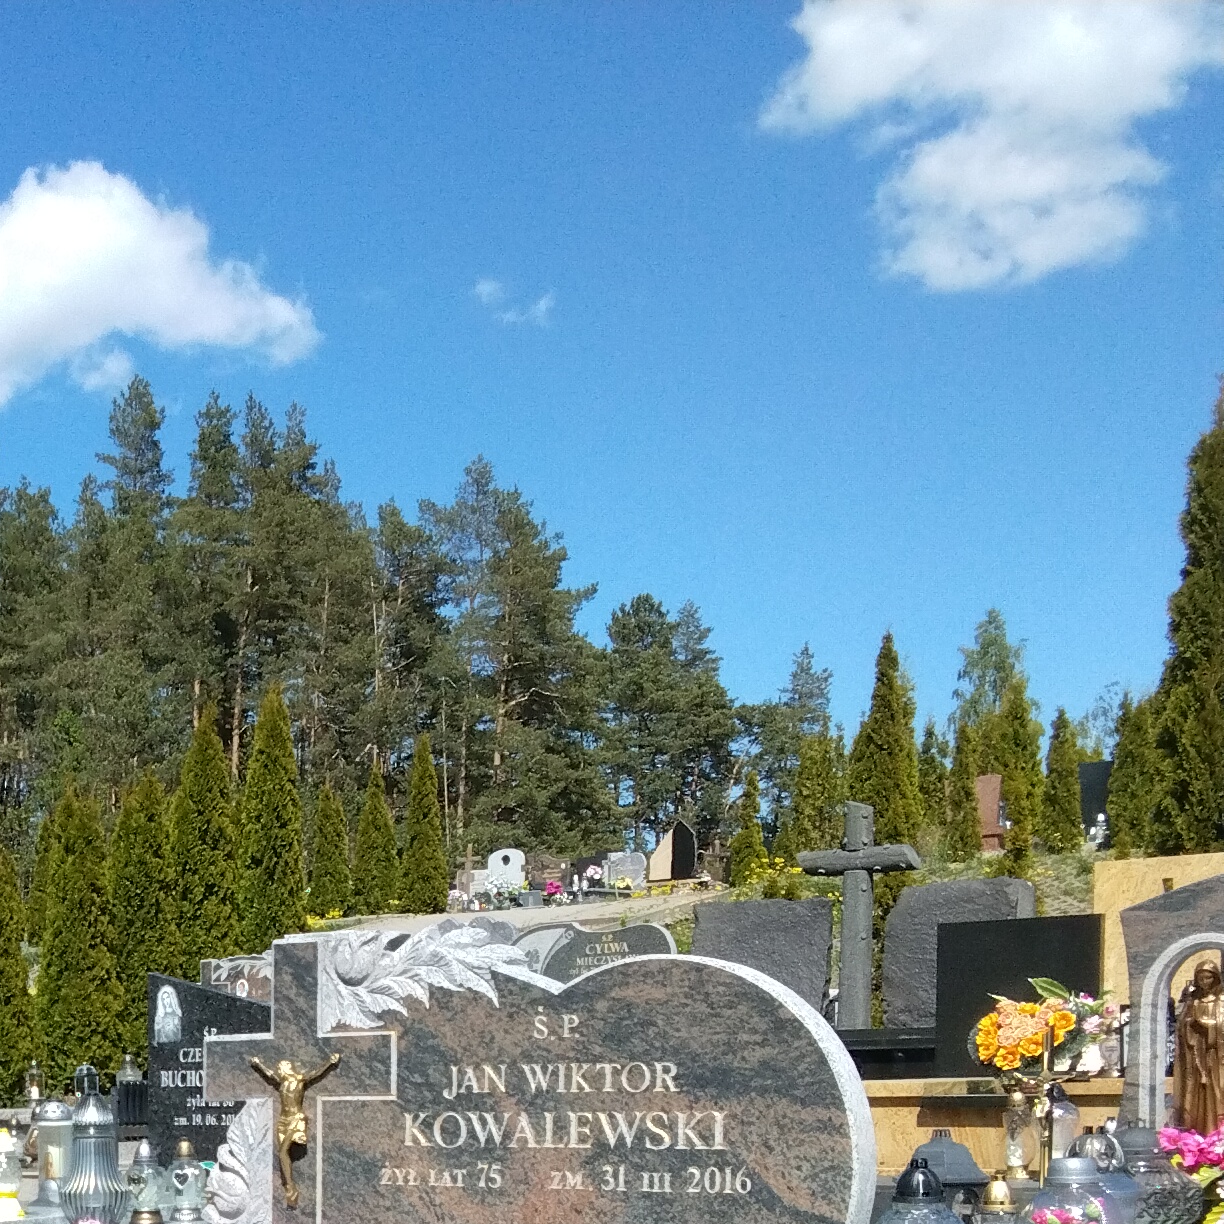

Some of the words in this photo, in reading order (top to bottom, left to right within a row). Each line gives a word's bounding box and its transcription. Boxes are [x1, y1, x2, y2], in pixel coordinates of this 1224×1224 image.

[179, 1047, 203, 1063] CZE
[160, 1069, 204, 1088] BUCHO
[443, 1064, 507, 1099] JAN
[521, 1061, 680, 1094] WIKTOR
[403, 1110, 728, 1151] KOWALEWSKI
[476, 1160, 503, 1189] 75
[601, 1163, 628, 1192] 31
[640, 1171, 673, 1194] III
[685, 1165, 752, 1194] 2016
